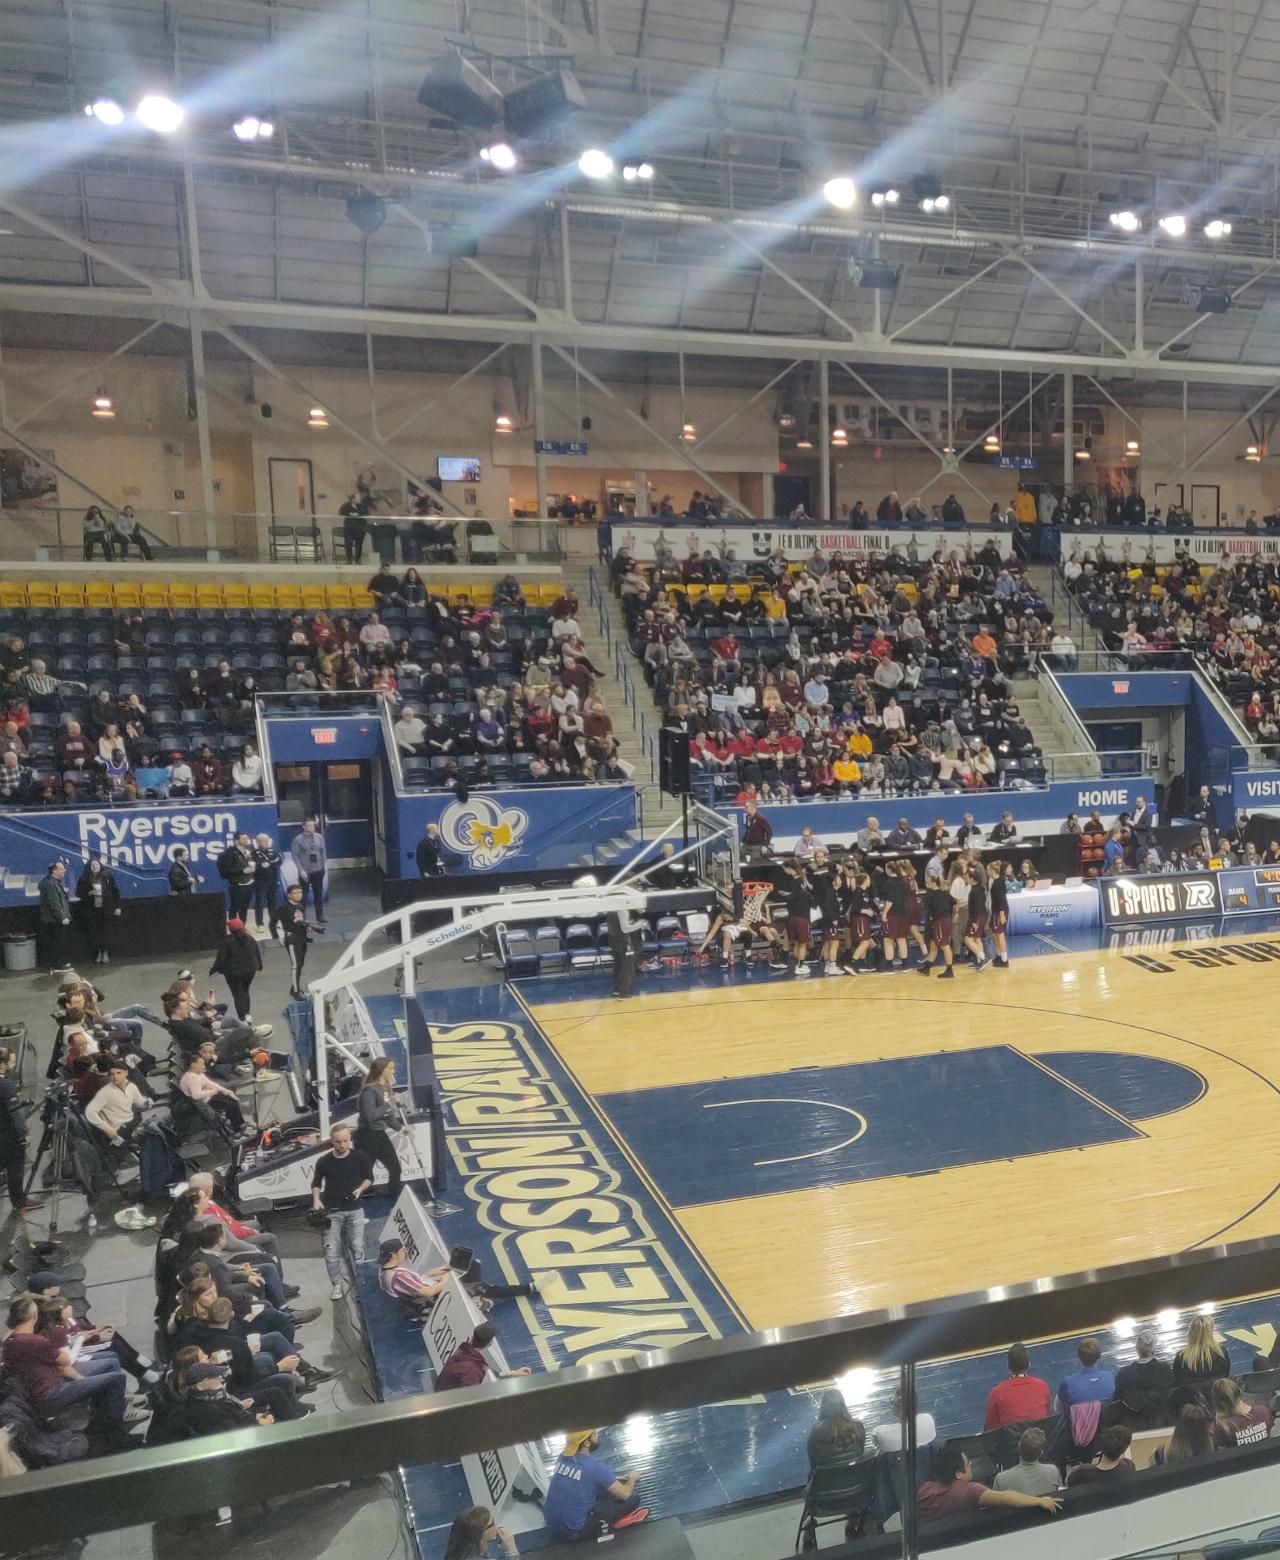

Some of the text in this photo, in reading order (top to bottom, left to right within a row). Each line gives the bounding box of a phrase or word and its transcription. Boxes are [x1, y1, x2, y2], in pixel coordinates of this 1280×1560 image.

[821, 534, 861, 550] BASKETBALL
[864, 535, 882, 550] FINAL
[1077, 788, 1128, 807] HOME
[78, 812, 238, 846] Ryerson
[80, 833, 273, 868] Universi
[1029, 903, 1071, 913] RYERSON
[1108, 887, 1121, 917] U
[1123, 882, 1177, 915] SPORTS
[1239, 895, 1248, 905] 4
[426, 922, 473, 946] Schelde
[1121, 953, 1177, 974] U
[432, 1022, 558, 1126] RAMS
[469, 1135, 690, 1367] YERSON
[1237, 1430, 1268, 1447] PRIDE
[481, 1450, 505, 1498] PORTS
